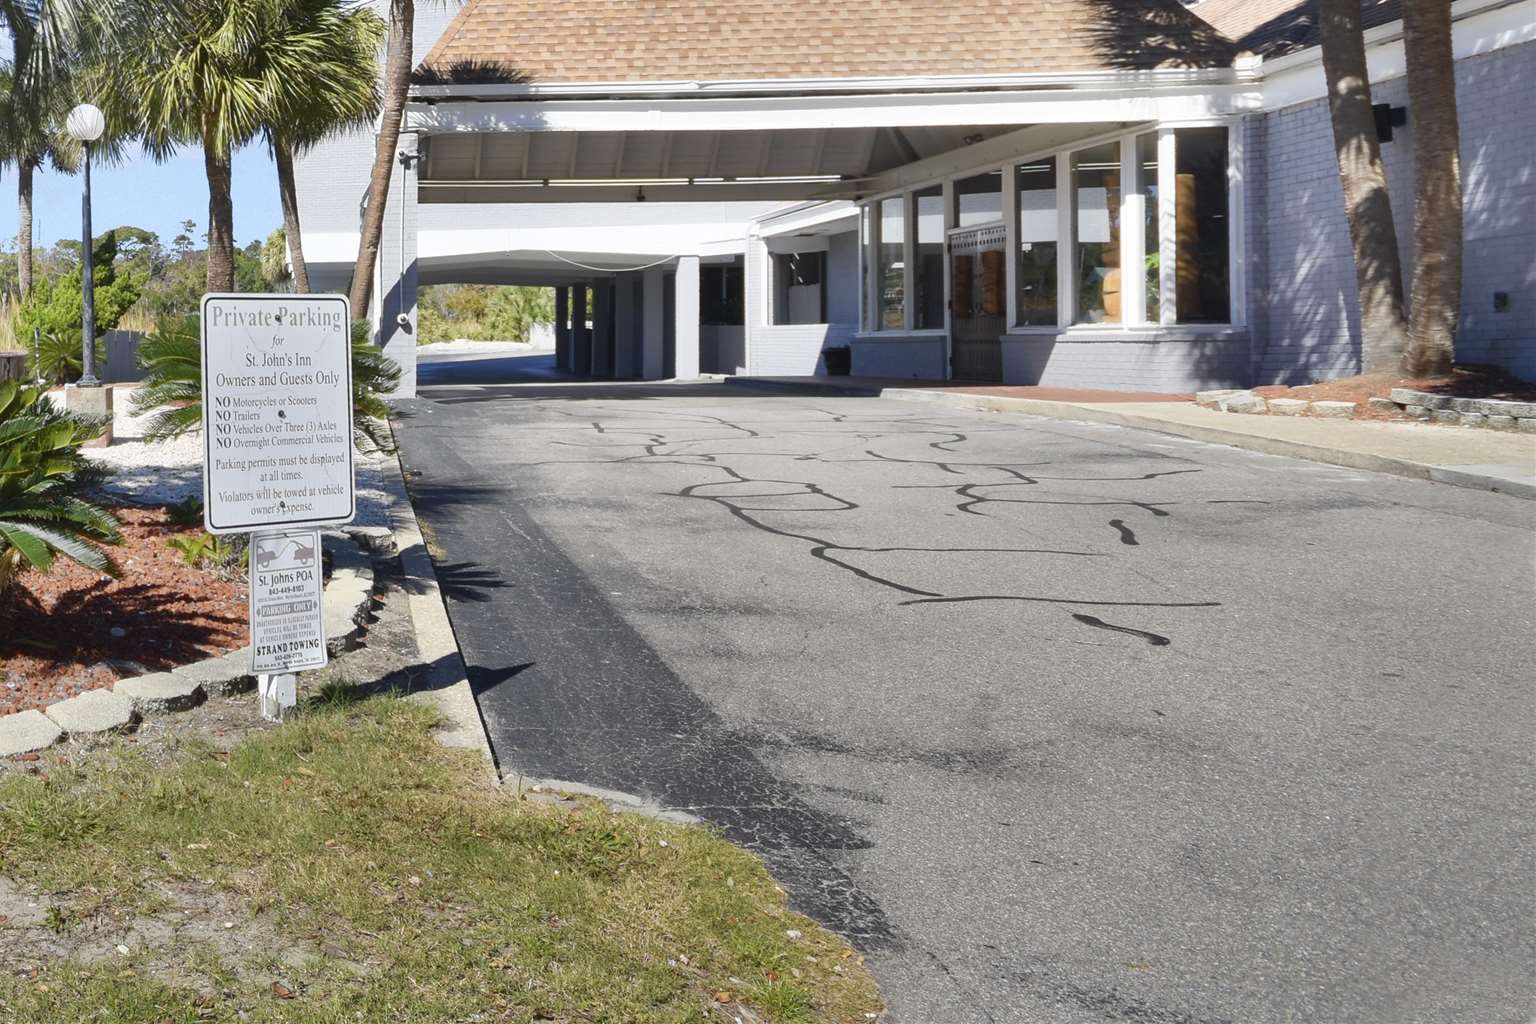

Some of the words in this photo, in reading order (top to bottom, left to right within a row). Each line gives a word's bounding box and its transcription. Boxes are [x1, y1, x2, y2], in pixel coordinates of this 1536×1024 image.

[213, 306, 272, 327] Private
[279, 306, 341, 332] Parking
[270, 334, 285, 350] for
[245, 353, 258, 367] St.
[262, 352, 292, 367] John's
[296, 352, 312, 366] Inn
[216, 372, 256, 387] Owners
[259, 372, 276, 385] and
[280, 371, 312, 385] Guests
[316, 370, 340, 388] Only
[215, 396, 230, 408] NO
[232, 396, 276, 409] Motorcycles
[278, 397, 286, 406] or
[288, 396, 317, 406] Scooters
[216, 410, 231, 421] NO
[233, 411, 260, 421] Trailers
[216, 424, 231, 435] NO
[233, 423, 263, 435] Vehicles
[265, 423, 283, 433] Over
[284, 422, 304, 432] Three
[318, 421, 337, 431] Axles
[216, 437, 231, 449] NO
[233, 437, 269, 450] Overnight
[271, 435, 313, 446] Commercial
[316, 434, 344, 444] Vehicles
[215, 459, 246, 472] Parking
[248, 457, 276, 471] permits
[279, 456, 297, 466] must
[299, 454, 308, 465] be
[310, 451, 344, 467] displayed
[260, 472, 268, 482] at
[269, 470, 279, 481] all
[281, 470, 304, 481] times.
[219, 491, 254, 502] Violators
[256, 487, 271, 500] will
[273, 488, 282, 499] be
[284, 486, 307, 497] towed
[308, 487, 316, 496] at
[318, 484, 344, 496] vehicle
[251, 504, 281, 515] owner's
[271, 573, 294, 587] Johns
[296, 570, 313, 582] POA
[256, 643, 288, 656] STRAND
[289, 638, 319, 651] TOWING
